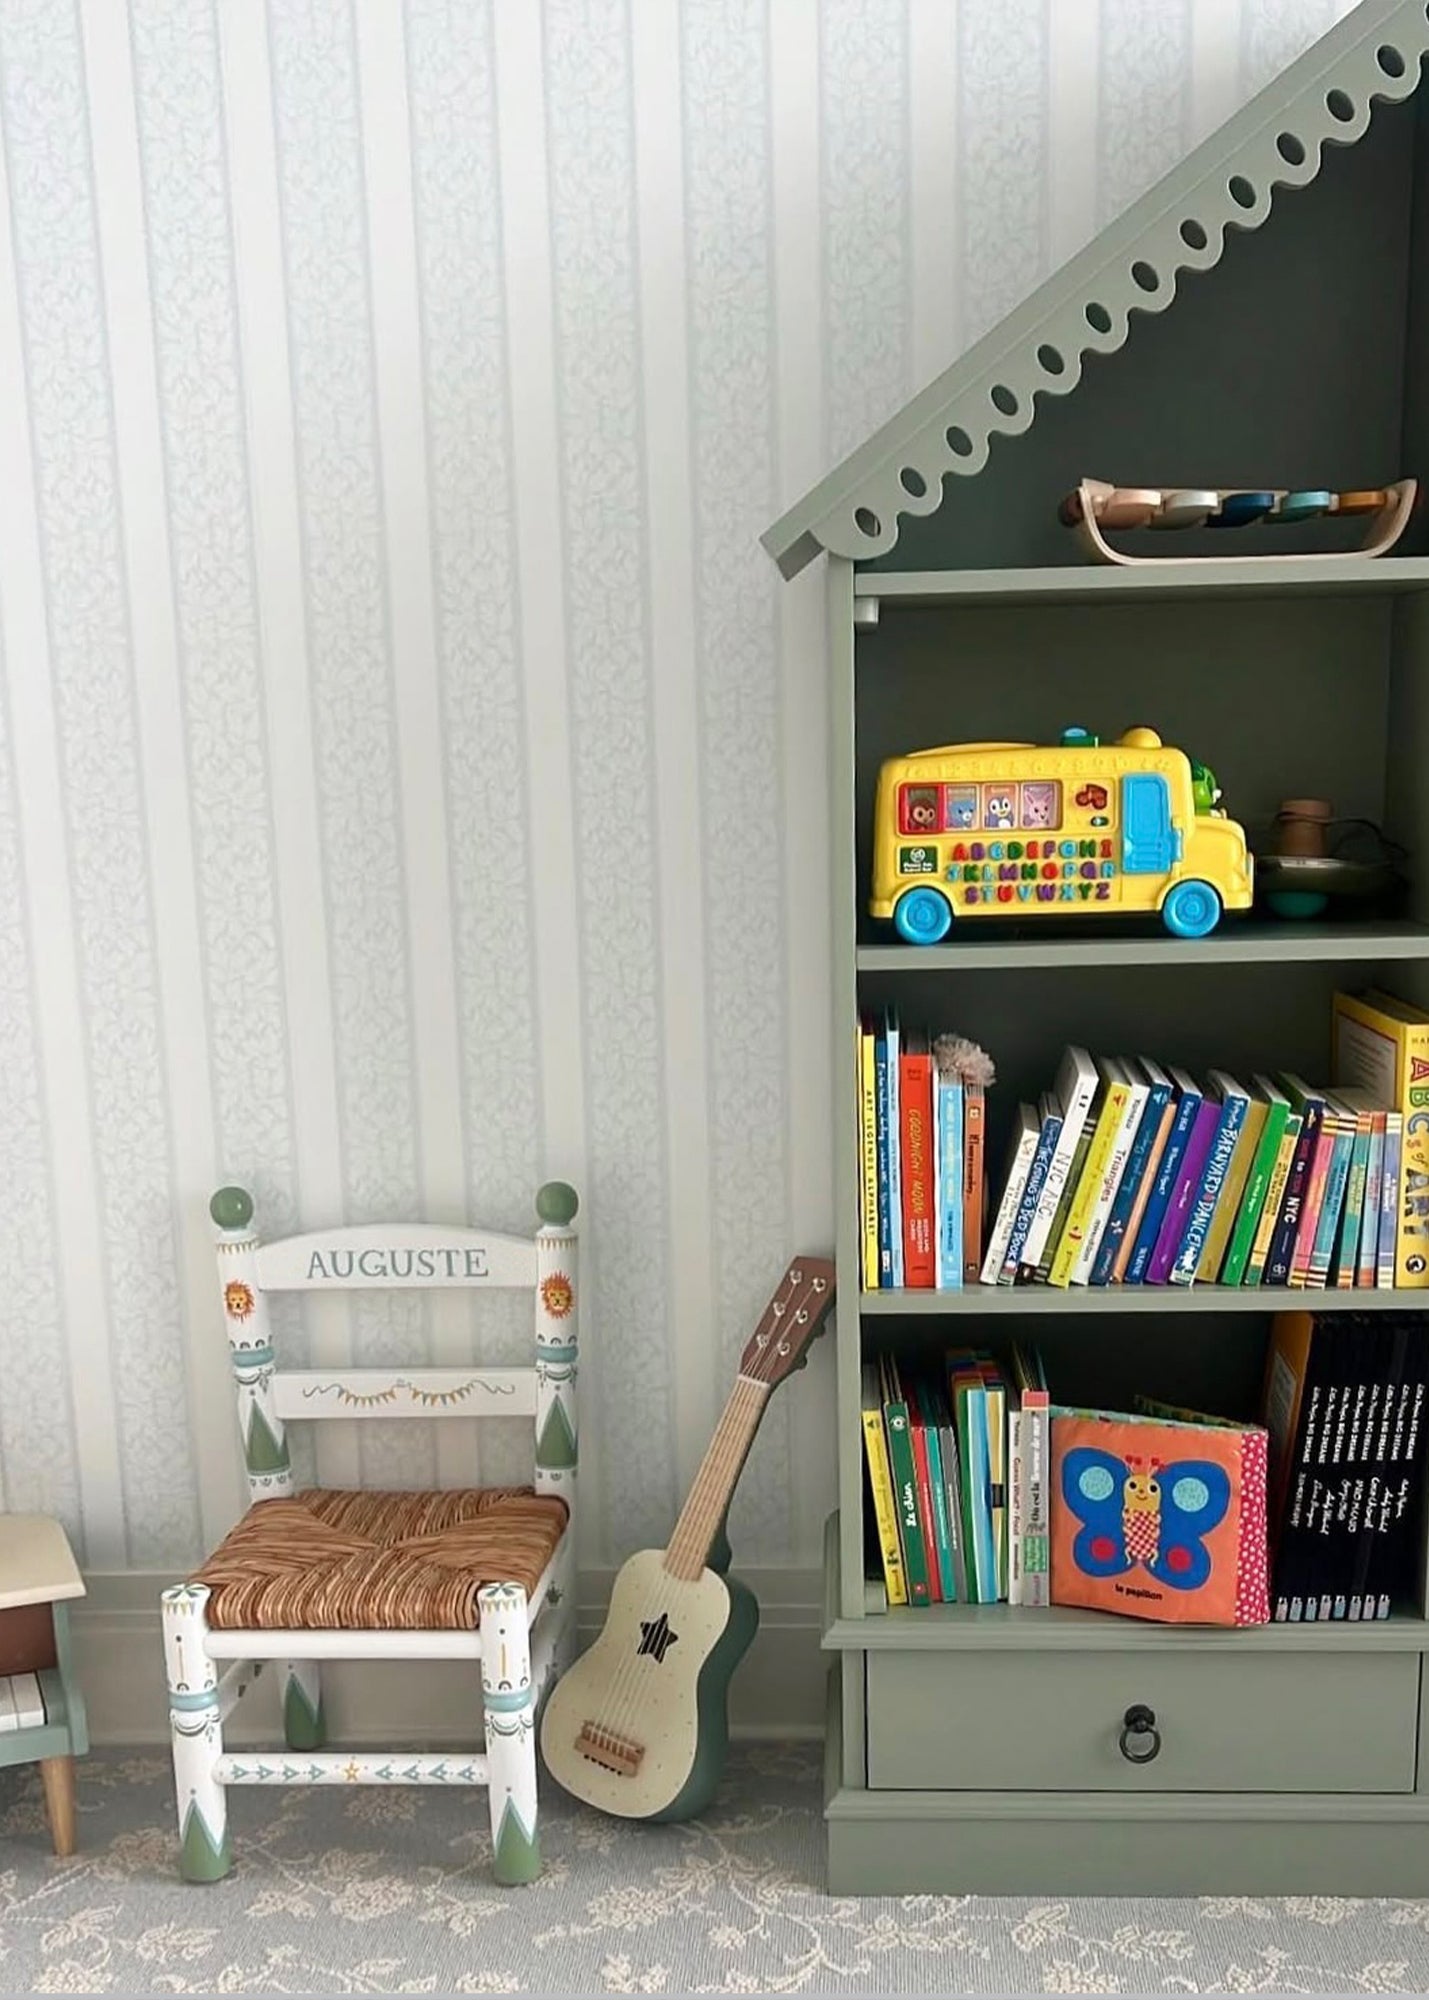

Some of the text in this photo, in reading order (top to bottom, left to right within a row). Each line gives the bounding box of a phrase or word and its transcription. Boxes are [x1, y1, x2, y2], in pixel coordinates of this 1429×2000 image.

[866, 1119, 875, 1170] LEGENDS
[910, 1108, 925, 1214] GOODNIGHT MOON
[1026, 1160, 1048, 1195] GOING
[1048, 1150, 1071, 1185] NYC
[1097, 1146, 1127, 1204] Triangles
[1204, 1129, 1241, 1196] BARNYARD
[1295, 1160, 1305, 1172] to
[1016, 1207, 1034, 1231] BED
[1187, 1199, 1214, 1248] DANCE!
[1282, 1195, 1301, 1224] NYC
[1006, 1229, 1026, 1261] BOOK
[307, 1249, 489, 1279] AUGUSTE
[900, 1481, 914, 1511] chien
[1125, 1587, 1163, 1600] papillon
